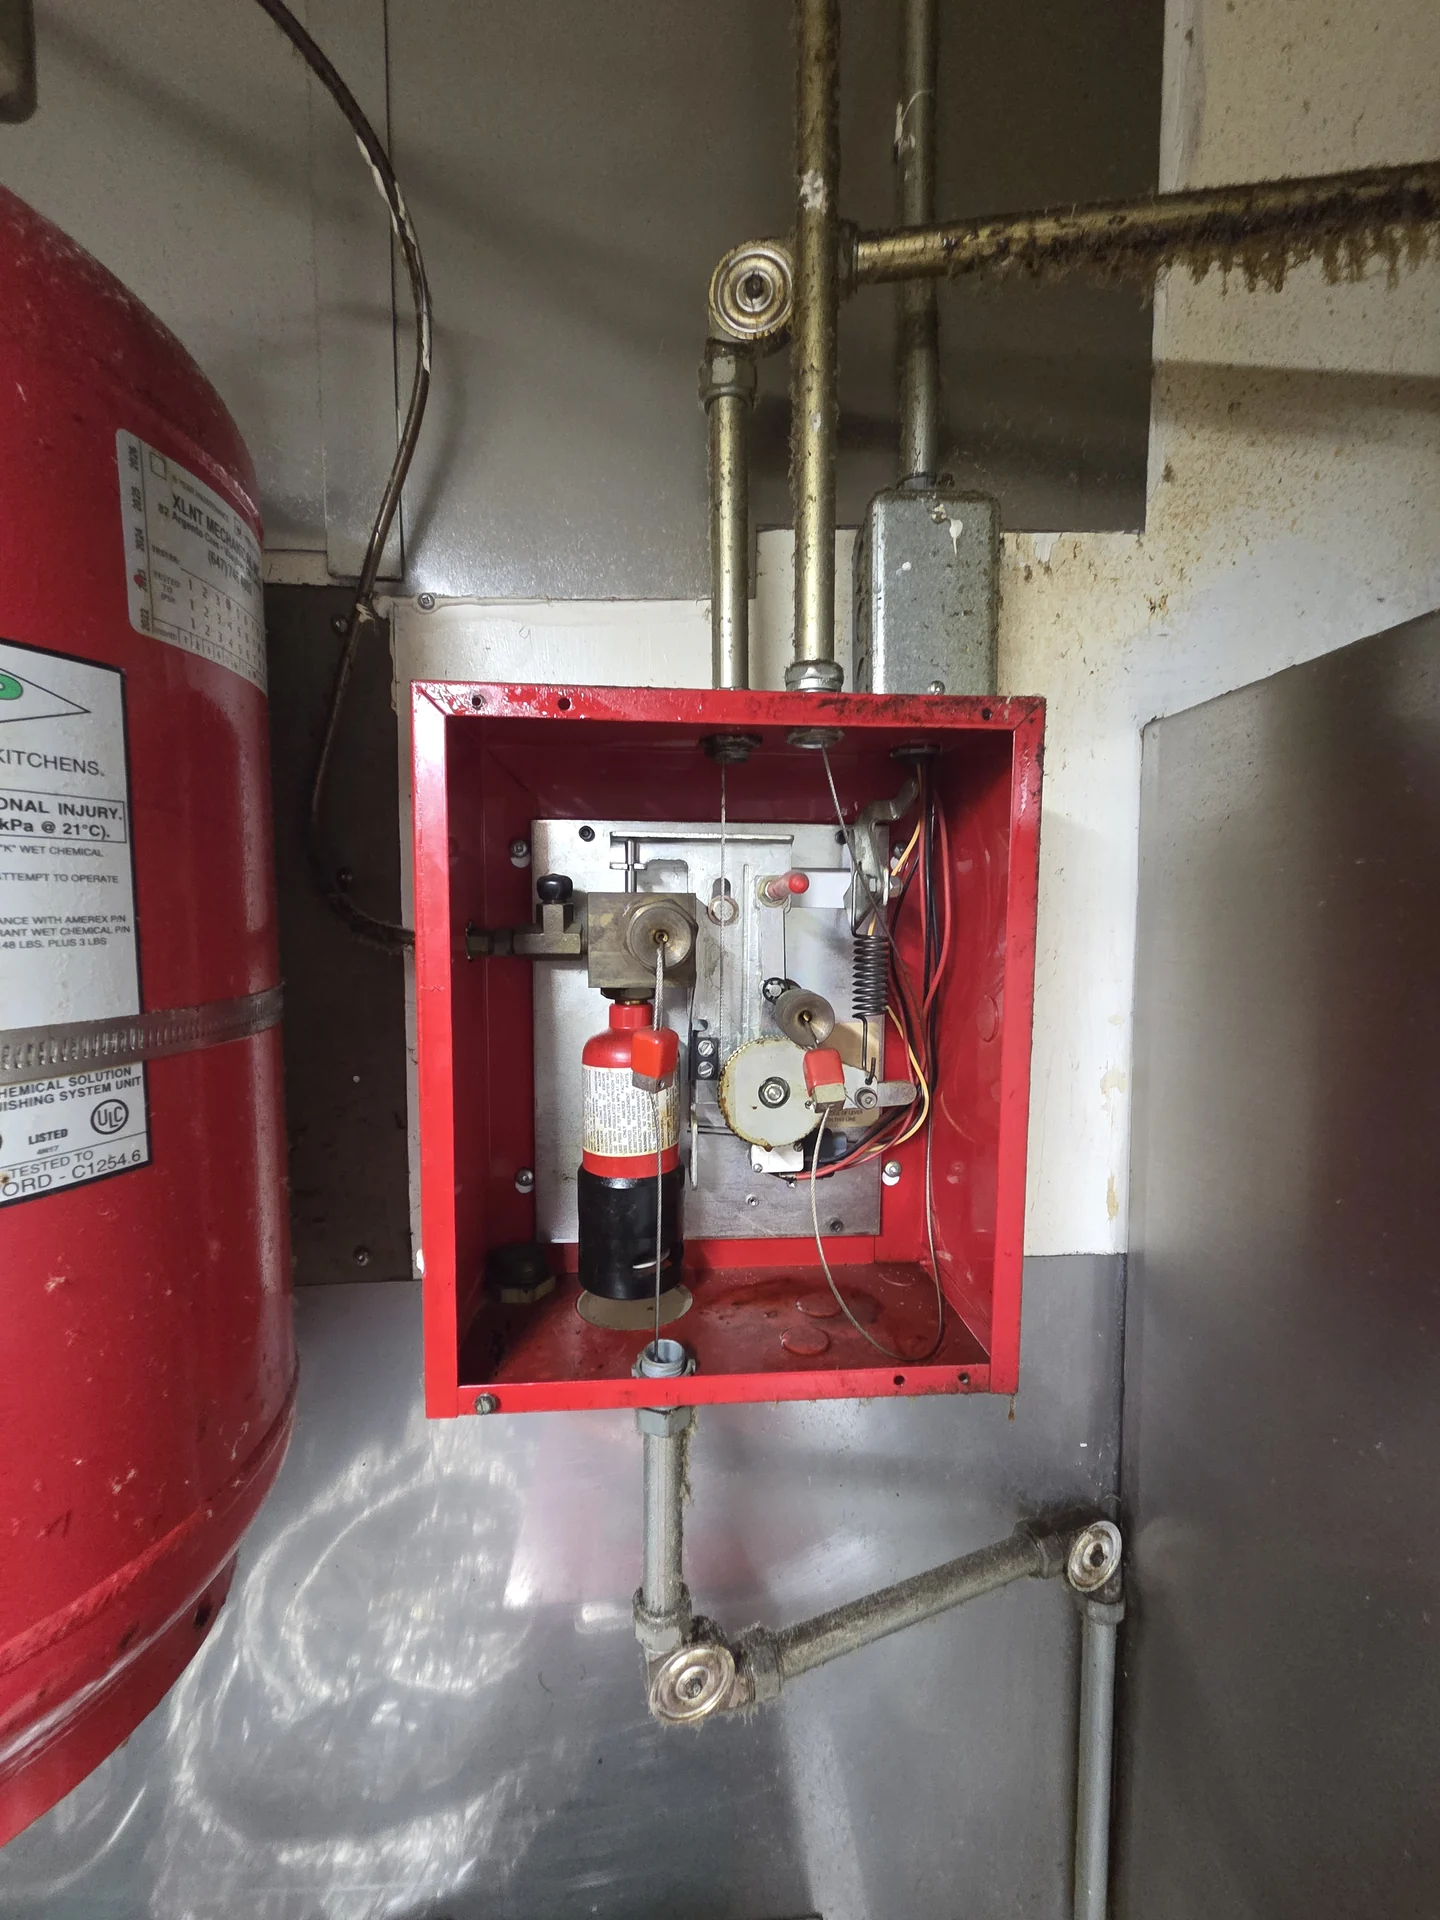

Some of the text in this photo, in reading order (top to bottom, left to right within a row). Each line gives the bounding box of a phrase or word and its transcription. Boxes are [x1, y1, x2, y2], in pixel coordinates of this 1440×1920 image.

[172, 491, 204, 526] XLNT
[140, 607, 151, 633] 2022
[58, 802, 122, 820] INJURY.
[0, 817, 110, 840] kPa @ 21°C).
[19, 844, 46, 855] WET
[49, 846, 104, 858] CHEMICAL
[0, 872, 120, 884] TTEMPT TO OPERATE
[32, 916, 62, 924] WITH
[65, 915, 108, 924] AMEREX
[30, 928, 57, 936] WET
[60, 926, 114, 936] CHEMICAL
[48, 938, 76, 948] PLUS
[79, 938, 86, 947] 3
[88, 937, 108, 946] LBS
[68, 1066, 132, 1088] SOLUTION
[60, 1082, 112, 1102] SYSTEM
[116, 1076, 142, 1091] UNIT
[97, 1106, 124, 1128] ULC
[28, 1128, 68, 1146] LISTED
[8, 1150, 94, 1179] TESTED TO
[72, 1148, 141, 1180] C1254.6
